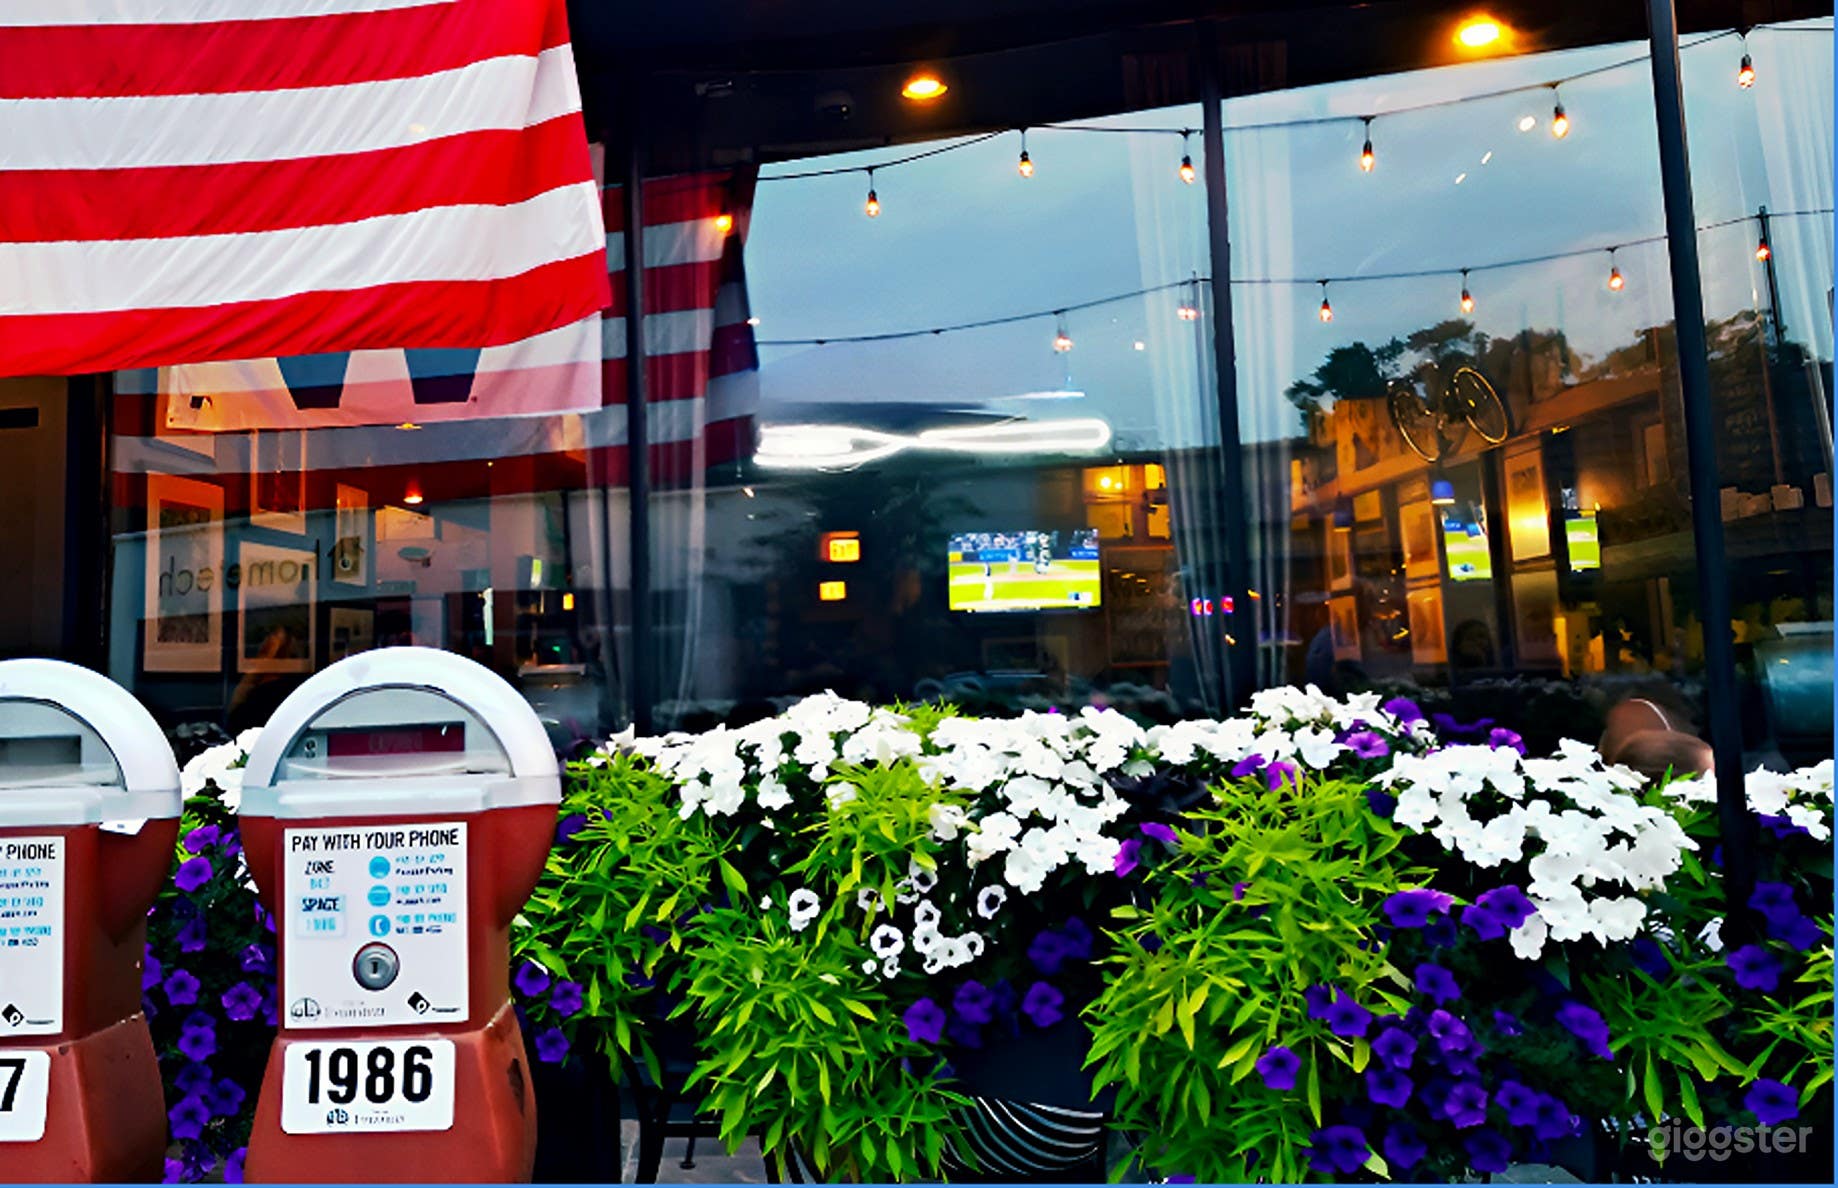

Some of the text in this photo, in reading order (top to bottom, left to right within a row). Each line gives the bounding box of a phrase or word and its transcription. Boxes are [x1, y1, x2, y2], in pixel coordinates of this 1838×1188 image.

[7, 843, 56, 860] PHONE
[292, 828, 459, 852] PAY WITH YOUR PHONE
[304, 1045, 433, 1104] 1986
